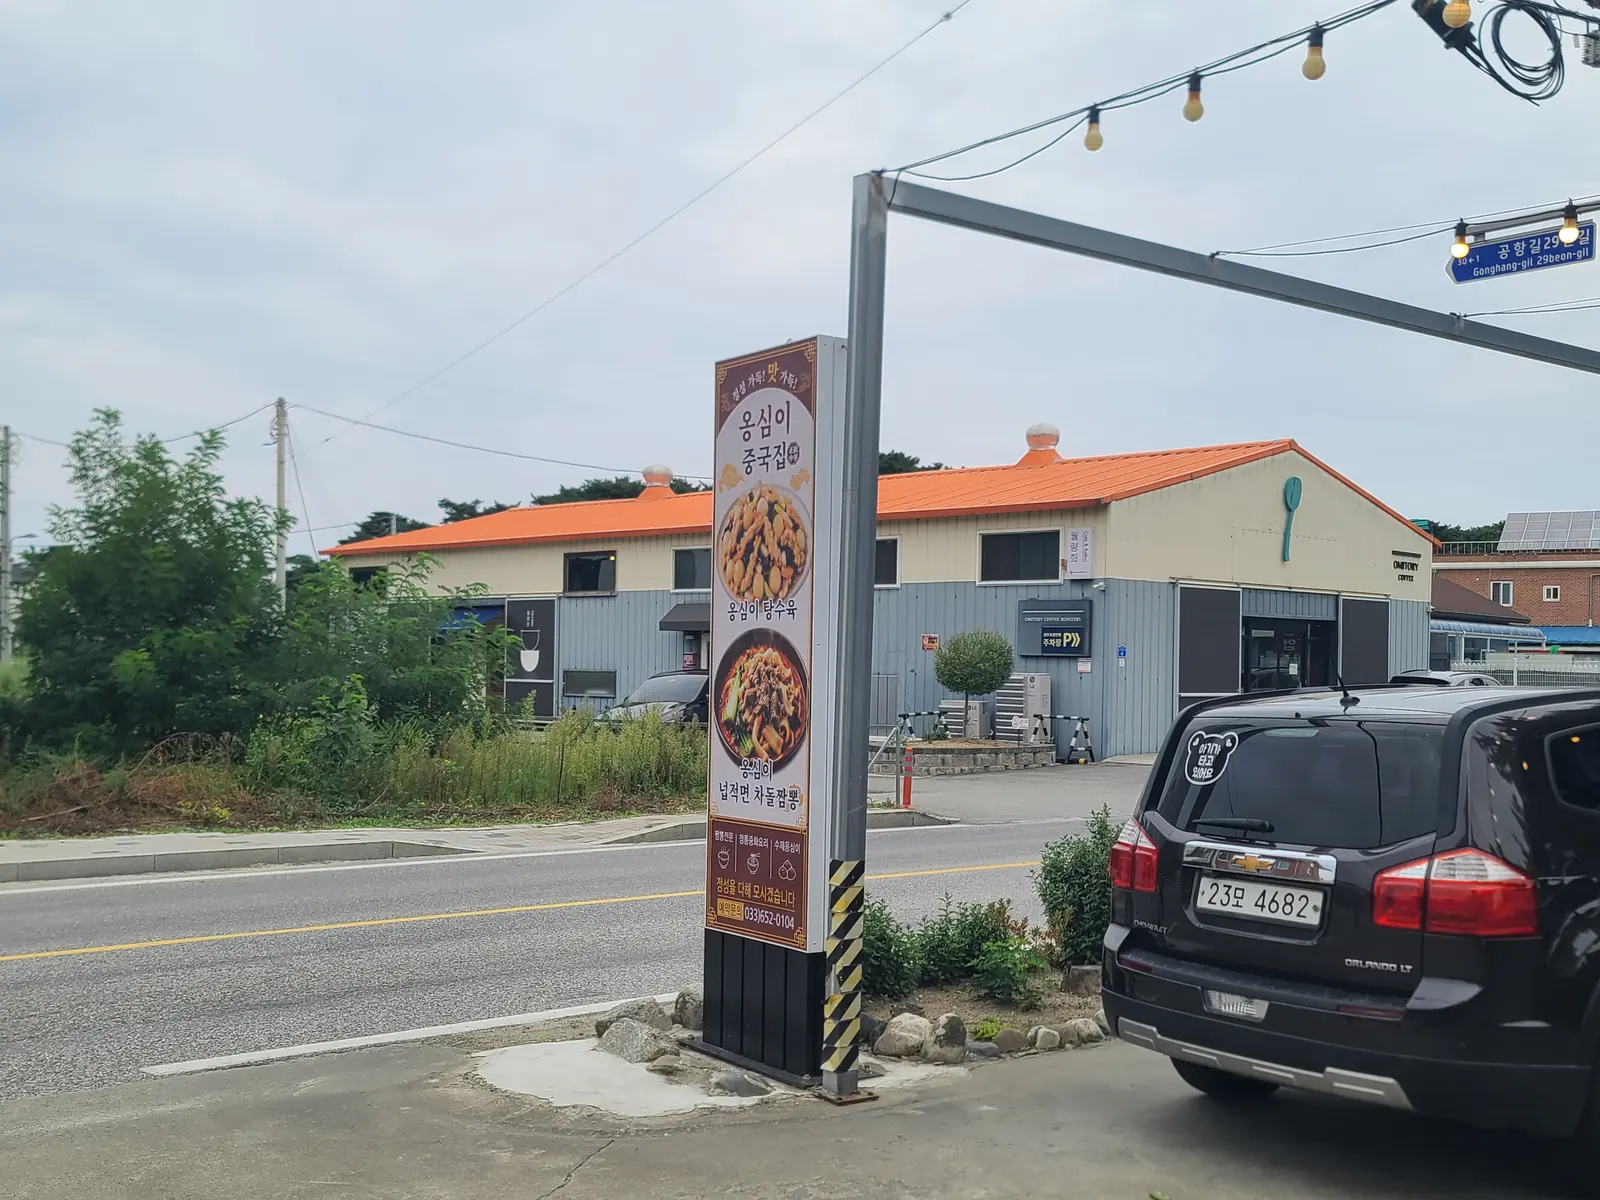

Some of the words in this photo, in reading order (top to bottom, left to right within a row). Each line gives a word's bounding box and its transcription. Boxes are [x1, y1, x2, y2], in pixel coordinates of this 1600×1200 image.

[1473, 257, 1534, 277] Gonghang-gil
[1537, 247, 1590, 266] 29beon-gil
[732, 380, 747, 402] 정성
[747, 370, 766, 388] 가득!
[767, 361, 780, 384] 맛
[779, 370, 799, 390] 가득!
[738, 400, 791, 443] 옹심이
[742, 441, 786, 476] 중국집
[727, 600, 760, 622] 옹심이
[763, 599, 798, 621] 탕수육
[1043, 638, 1062, 648] 주차장
[1197, 754, 1214, 766] 타고
[1198, 742, 1222, 755] 아기가
[740, 758, 774, 781] 옹심이
[1191, 766, 1214, 779] 있어요
[719, 781, 750, 804] 넙적면
[753, 785, 800, 811] 차돌짬뽕
[774, 840, 801, 855] 수제옹심이
[716, 877, 736, 896] 정성을
[738, 881, 752, 899] 다해
[753, 885, 796, 909] 모시겠습니다
[1207, 882, 1246, 909] 23모
[1254, 889, 1310, 919] 4682
[718, 900, 743, 918] 예약문의
[744, 906, 795, 930] 033)652-0104
[1133, 919, 1168, 934] CHEVROLET
[1344, 958, 1398, 972] ORLANDO
[1400, 964, 1414, 974] LT
